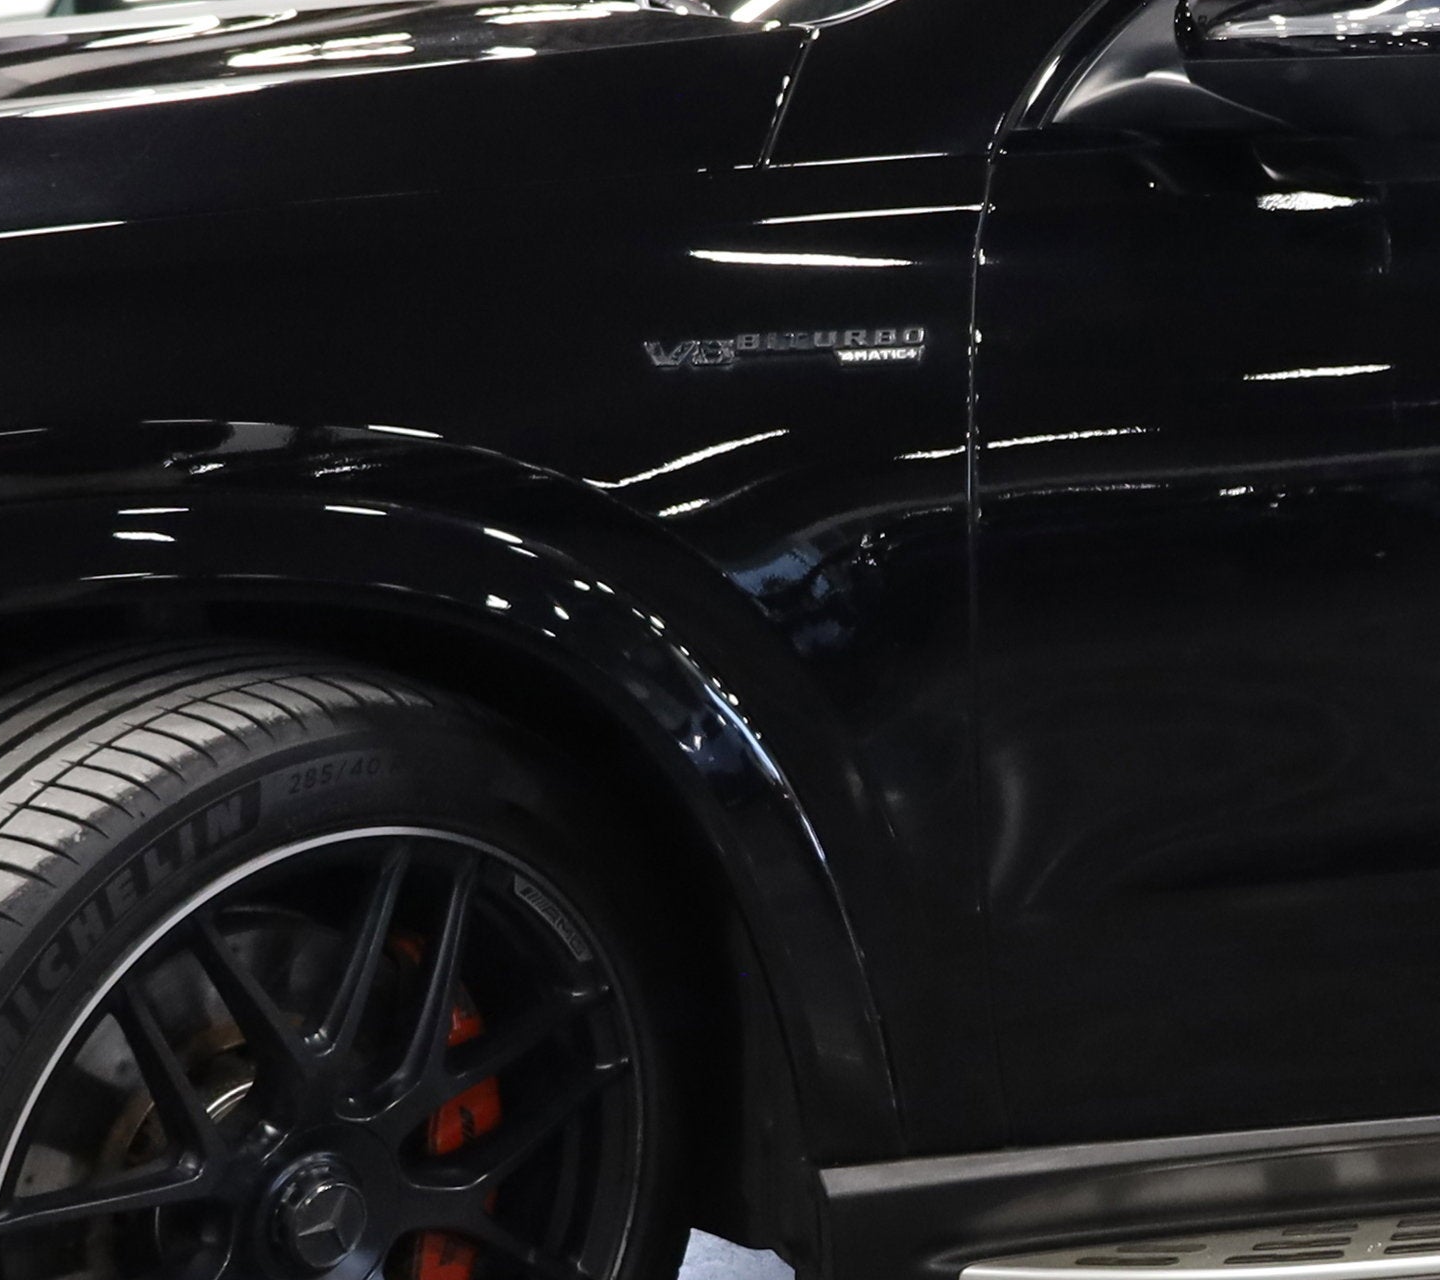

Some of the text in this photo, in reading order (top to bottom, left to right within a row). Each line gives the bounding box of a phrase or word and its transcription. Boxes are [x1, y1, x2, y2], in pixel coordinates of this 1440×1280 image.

[643, 327, 924, 366] V8 BITURBO
[288, 758, 381, 795] 285/40
